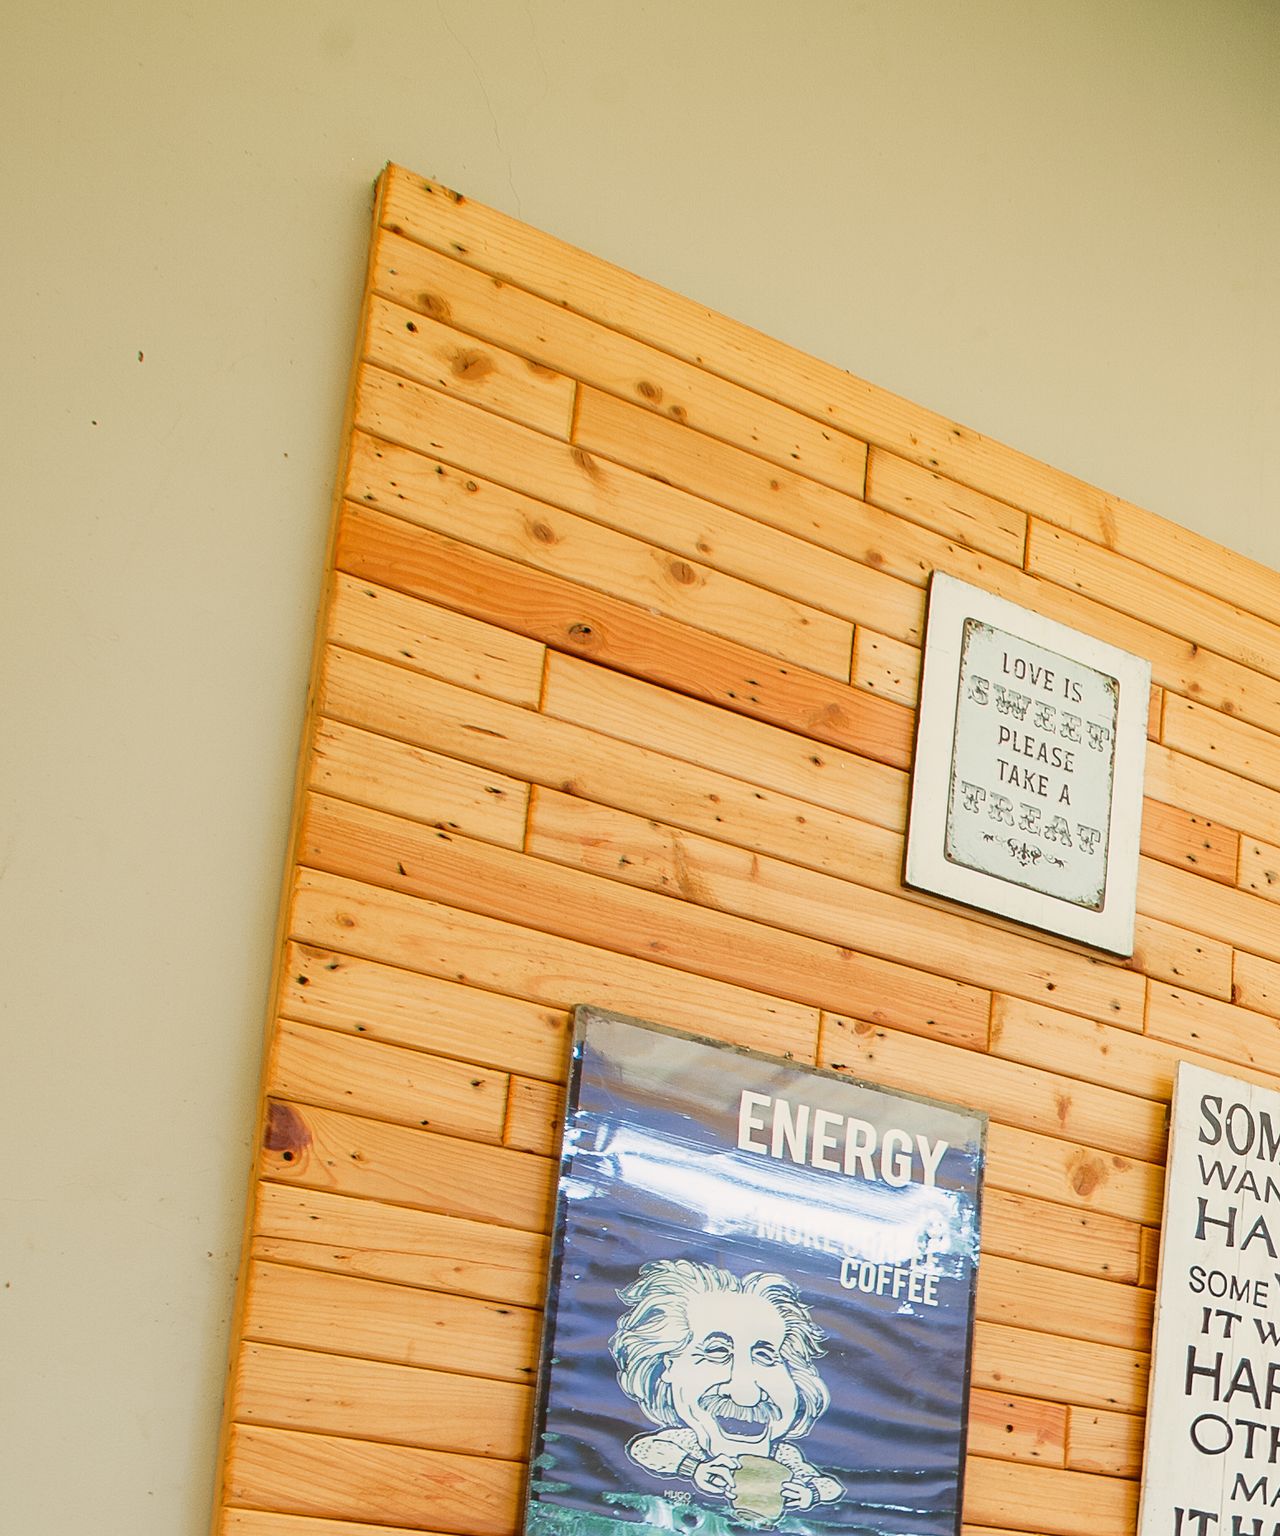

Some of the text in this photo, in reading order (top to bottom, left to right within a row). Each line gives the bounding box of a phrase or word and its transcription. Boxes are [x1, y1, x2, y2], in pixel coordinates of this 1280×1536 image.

[1001, 652, 1083, 704] LOVE IS
[966, 674, 1111, 753] SWEET
[997, 725, 1075, 773] PLEASE
[996, 758, 1071, 806] TAKE A
[960, 780, 1101, 856] TREAT
[735, 1088, 950, 1190] ENERGY
[839, 1256, 940, 1307] COFFEE
[1188, 1265, 1269, 1308] SOME
[1200, 1307, 1242, 1339] IT
